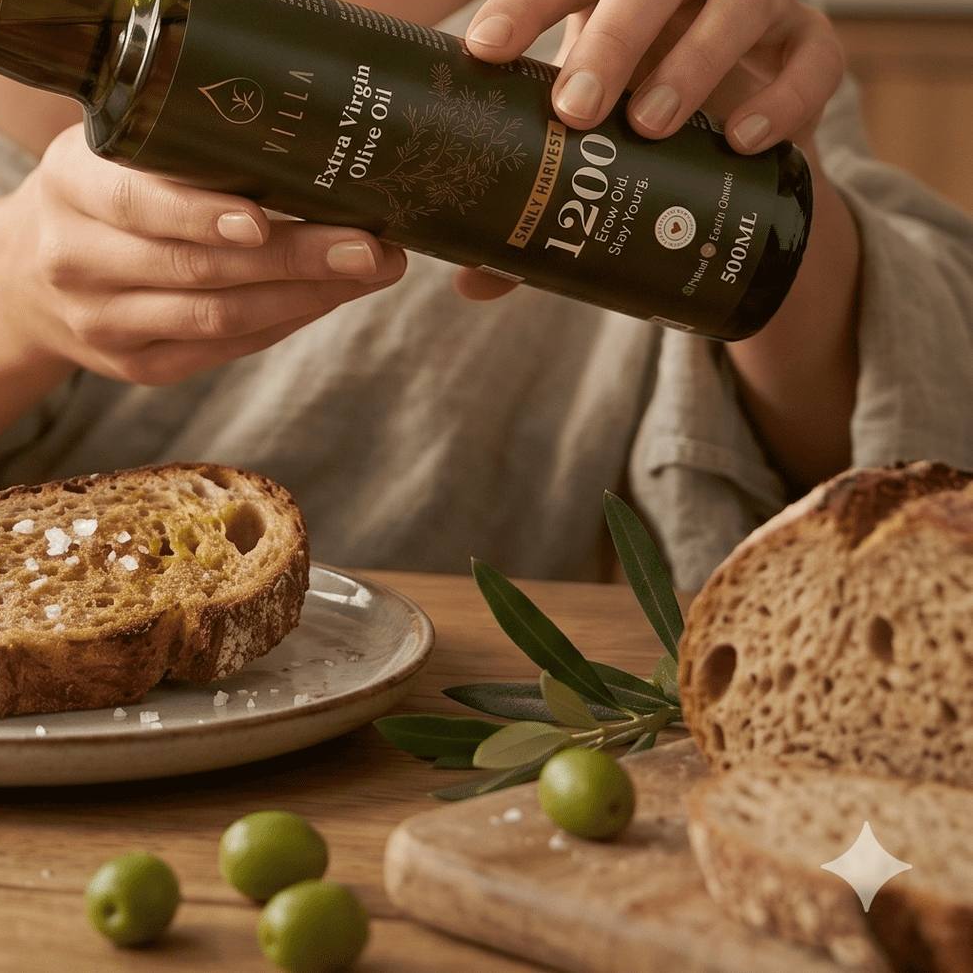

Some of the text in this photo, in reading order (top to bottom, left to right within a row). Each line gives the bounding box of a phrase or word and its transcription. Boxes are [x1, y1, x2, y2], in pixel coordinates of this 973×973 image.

[262, 70, 314, 153] VILLA
[314, 65, 372, 189] Extra Virgin
[349, 88, 393, 179] Olive Oil
[515, 130, 563, 241] SANLY HARVEST
[545, 133, 616, 258] 1200
[611, 175, 629, 202] Old.
[720, 212, 758, 284] 500ML
